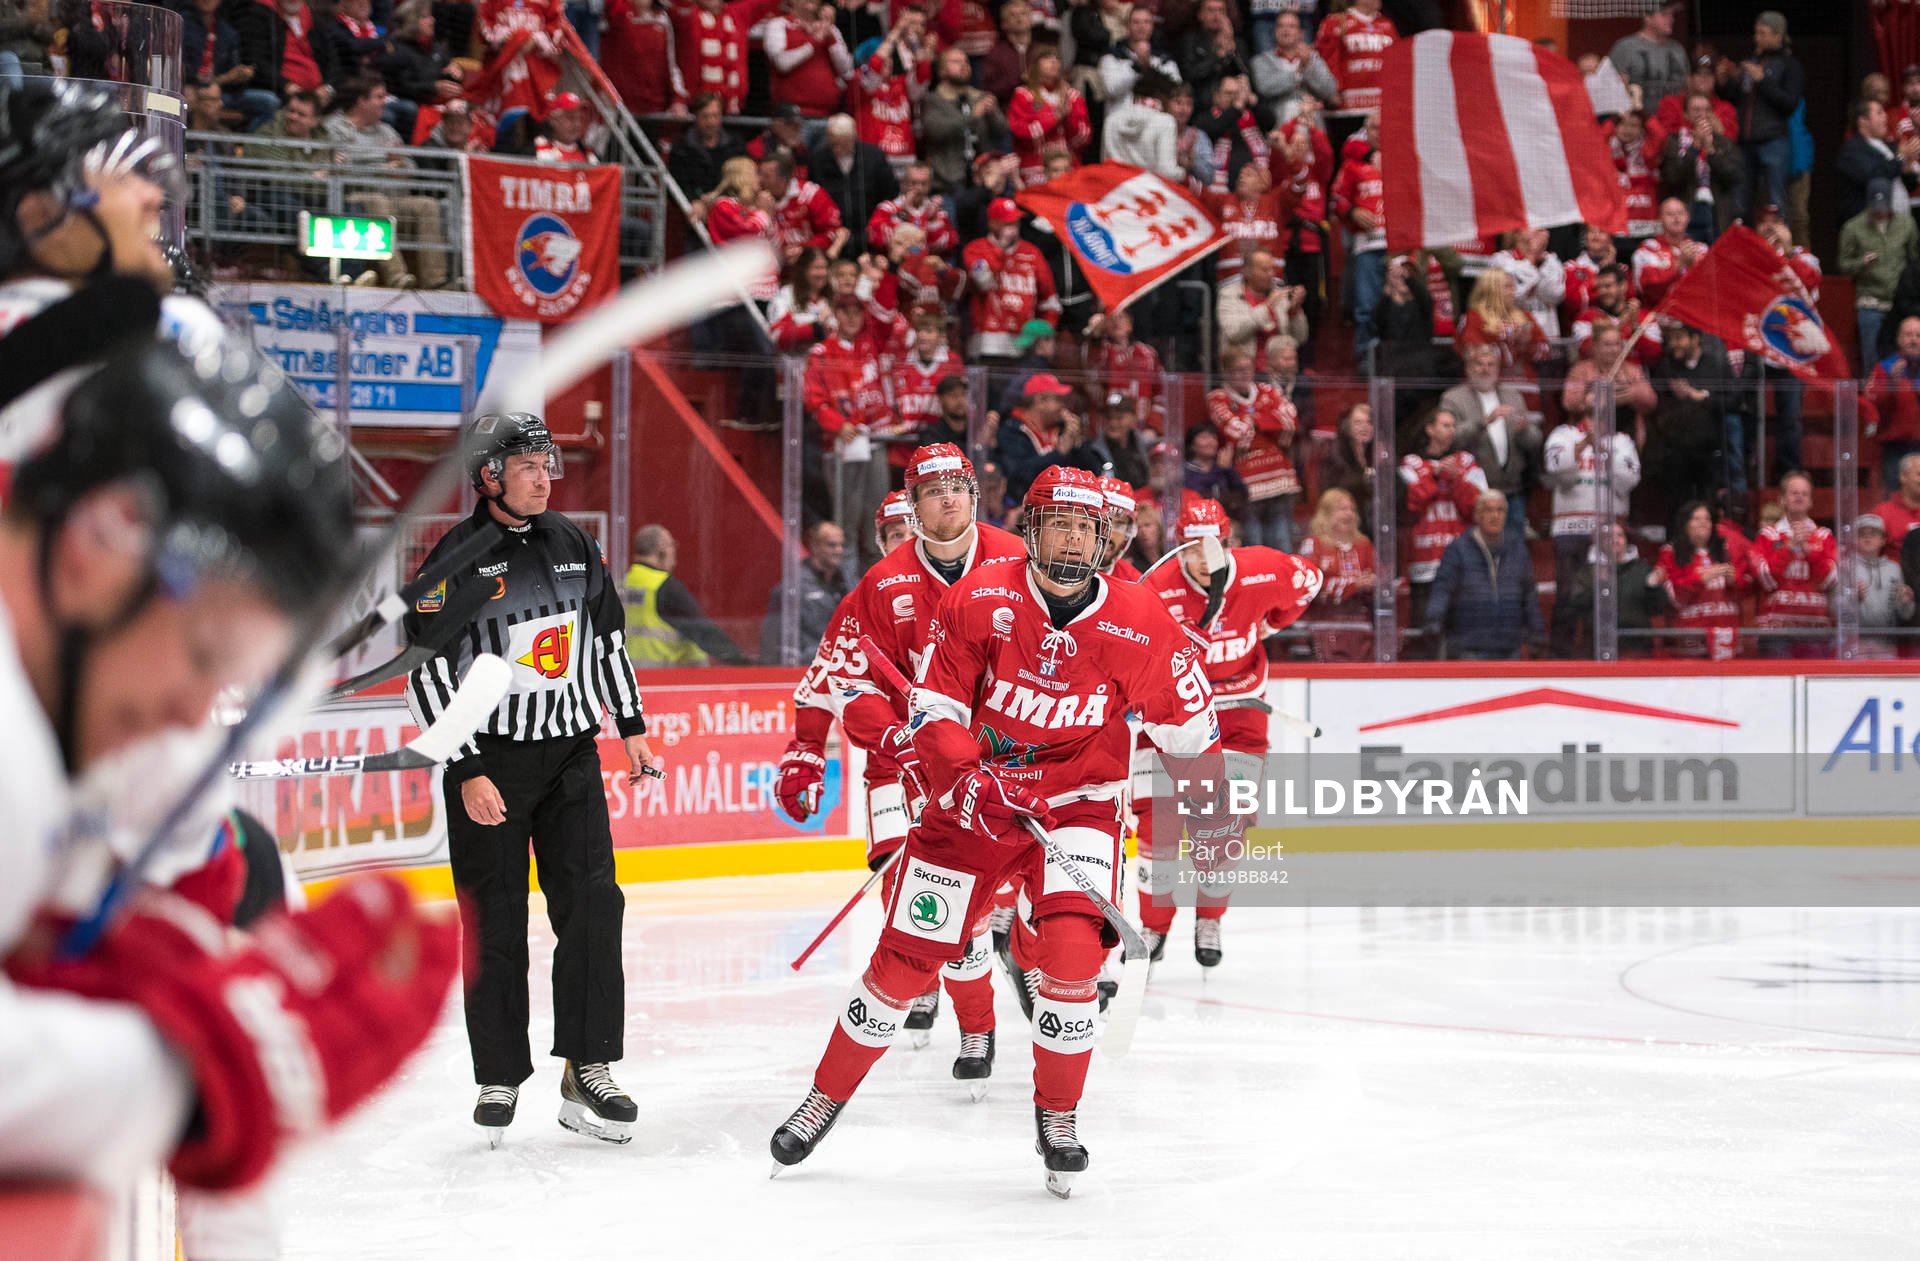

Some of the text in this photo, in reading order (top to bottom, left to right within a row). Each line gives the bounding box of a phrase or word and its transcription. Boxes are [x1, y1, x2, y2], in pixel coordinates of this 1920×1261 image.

[500, 171, 592, 213] TIMRÅ
[417, 345, 453, 377] AB
[877, 574, 921, 591] stadium
[970, 586, 1024, 603] stadium
[1096, 620, 1150, 646] stadium
[532, 624, 569, 679] Aj
[828, 635, 869, 676] 63
[1040, 661, 1056, 676] ST
[1176, 659, 1213, 713] 91
[697, 701, 787, 735] Måleri
[999, 769, 1043, 781] Kapell
[1360, 743, 1740, 804] Faradium
[634, 755, 668, 818] PÅ
[1046, 854, 1112, 870] BRNERS
[913, 867, 962, 889] ŠKODA
[966, 947, 988, 964] SCA
[1050, 987, 1086, 996] BAUER
[862, 1028, 878, 1038] Care
[866, 1018, 896, 1032] SCA
[1063, 1018, 1094, 1033] SCA
